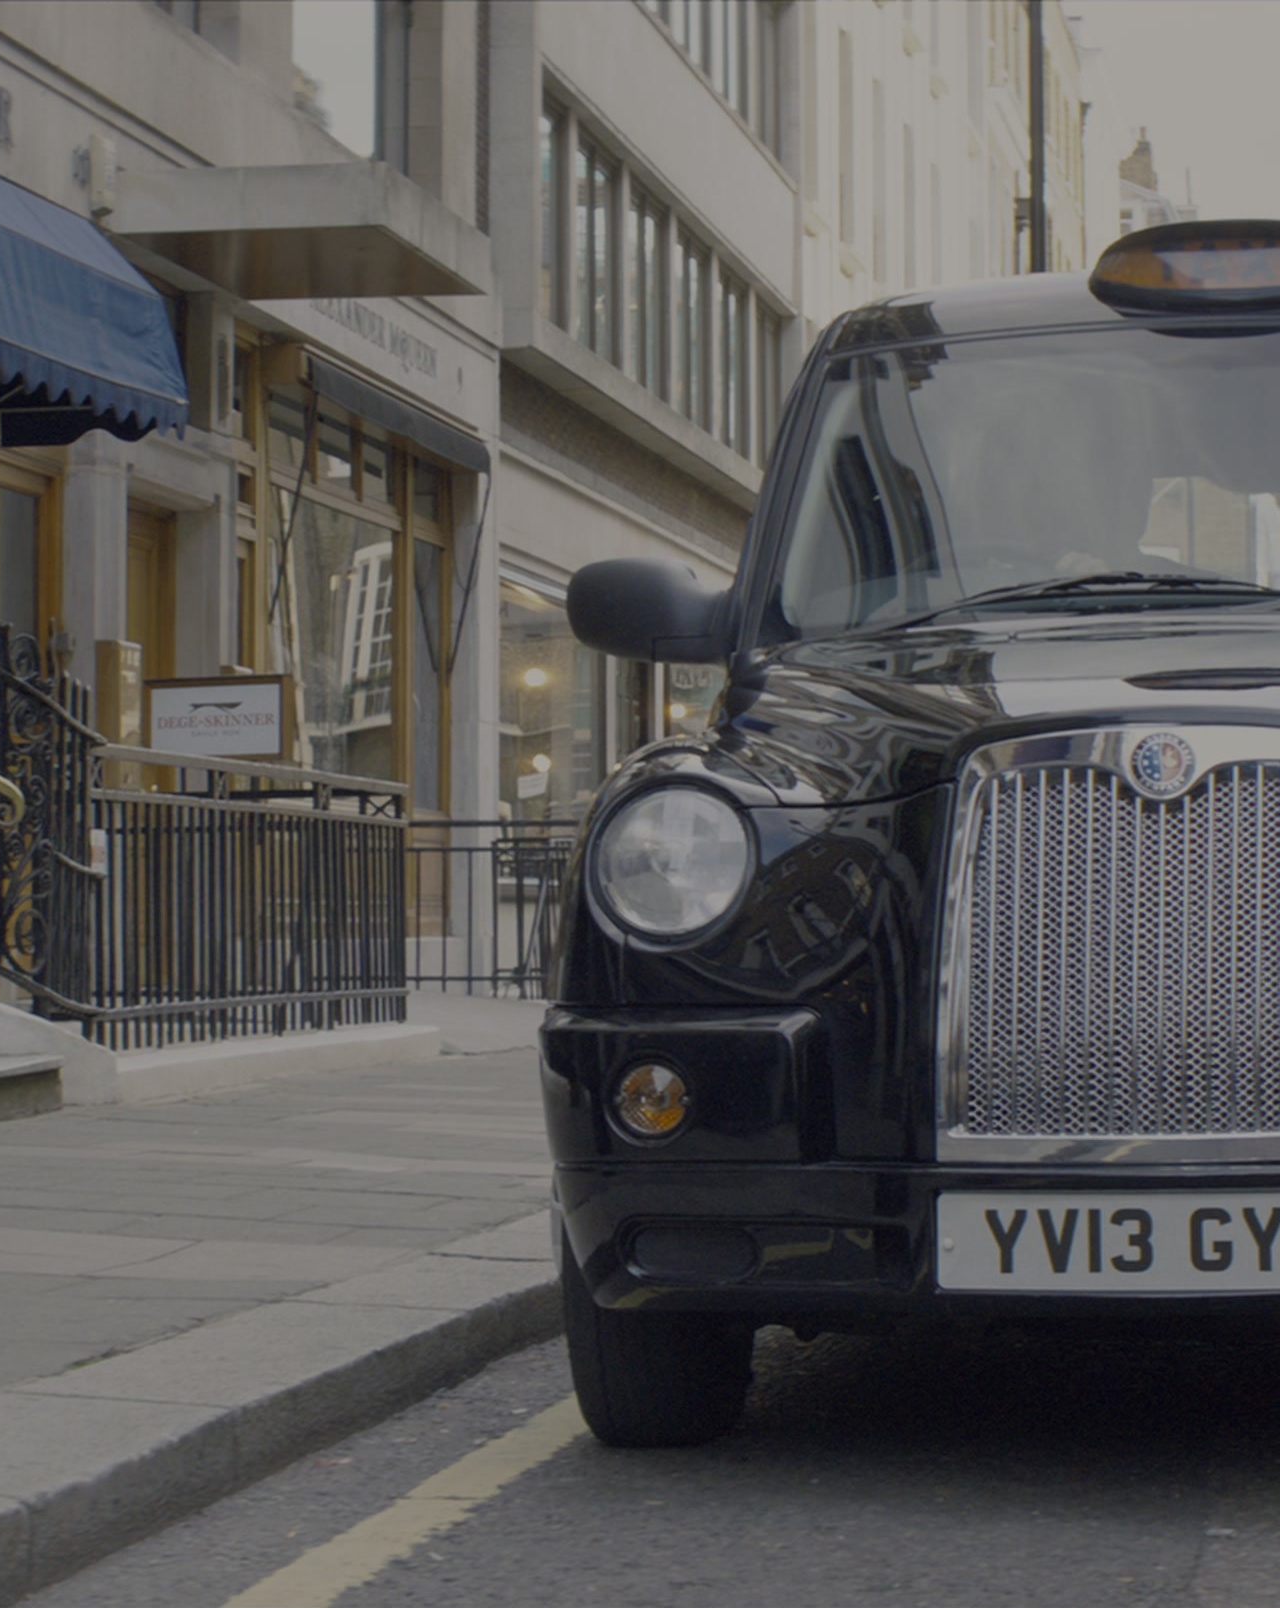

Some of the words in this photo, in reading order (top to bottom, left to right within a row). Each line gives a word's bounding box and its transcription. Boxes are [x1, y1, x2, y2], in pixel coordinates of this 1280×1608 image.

[157, 715, 198, 730] DEGE
[204, 713, 275, 728] SKINNER
[985, 1208, 1154, 1274] YV13
